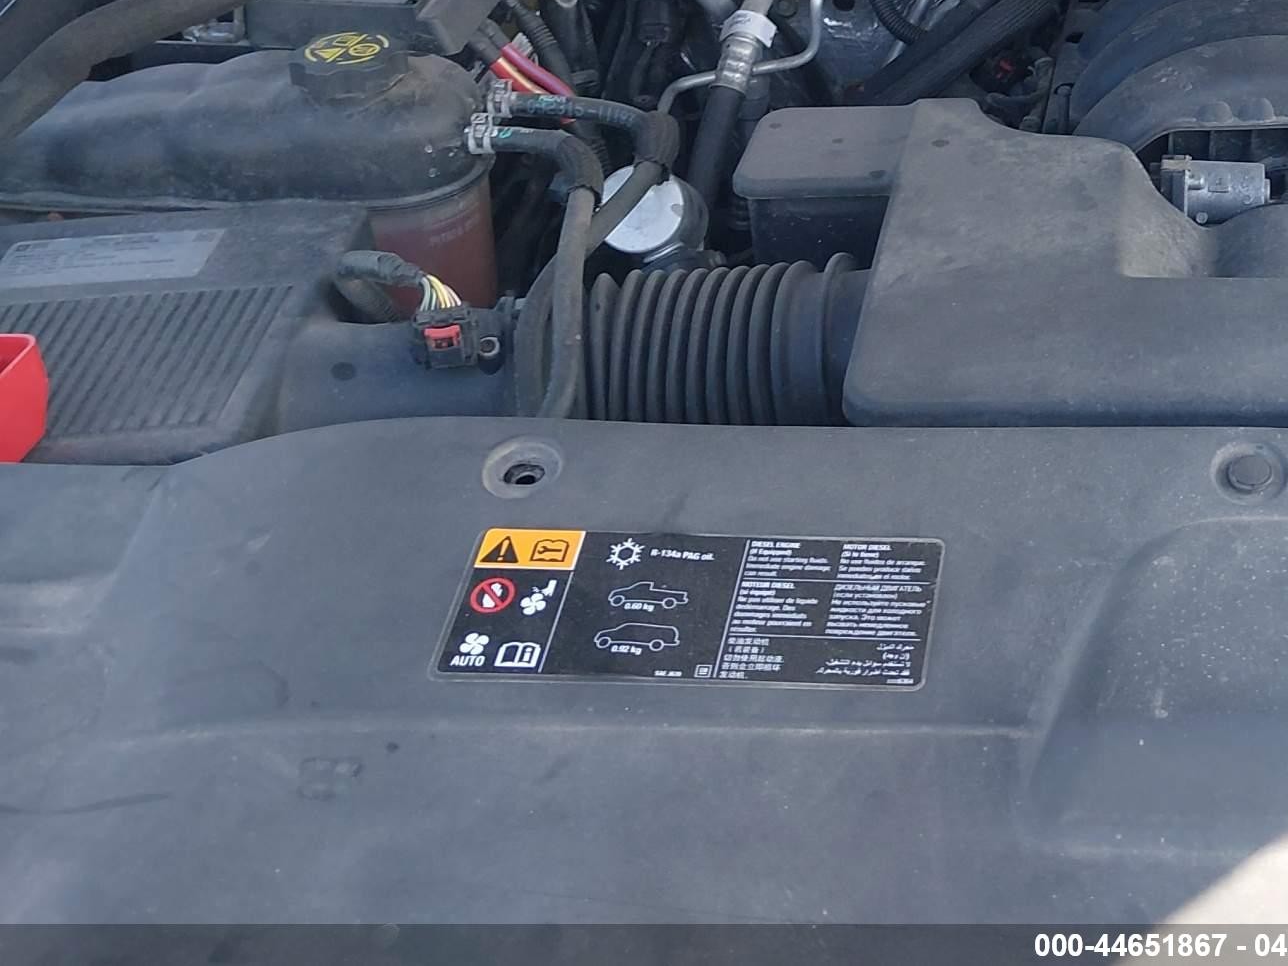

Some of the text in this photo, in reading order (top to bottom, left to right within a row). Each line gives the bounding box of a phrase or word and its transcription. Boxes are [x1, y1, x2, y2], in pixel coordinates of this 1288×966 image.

[650, 548, 715, 561] R-134a PAG oil.
[624, 602, 655, 612] 0.60 kg
[630, 645, 642, 655] kg
[449, 655, 486, 667] AUTO
